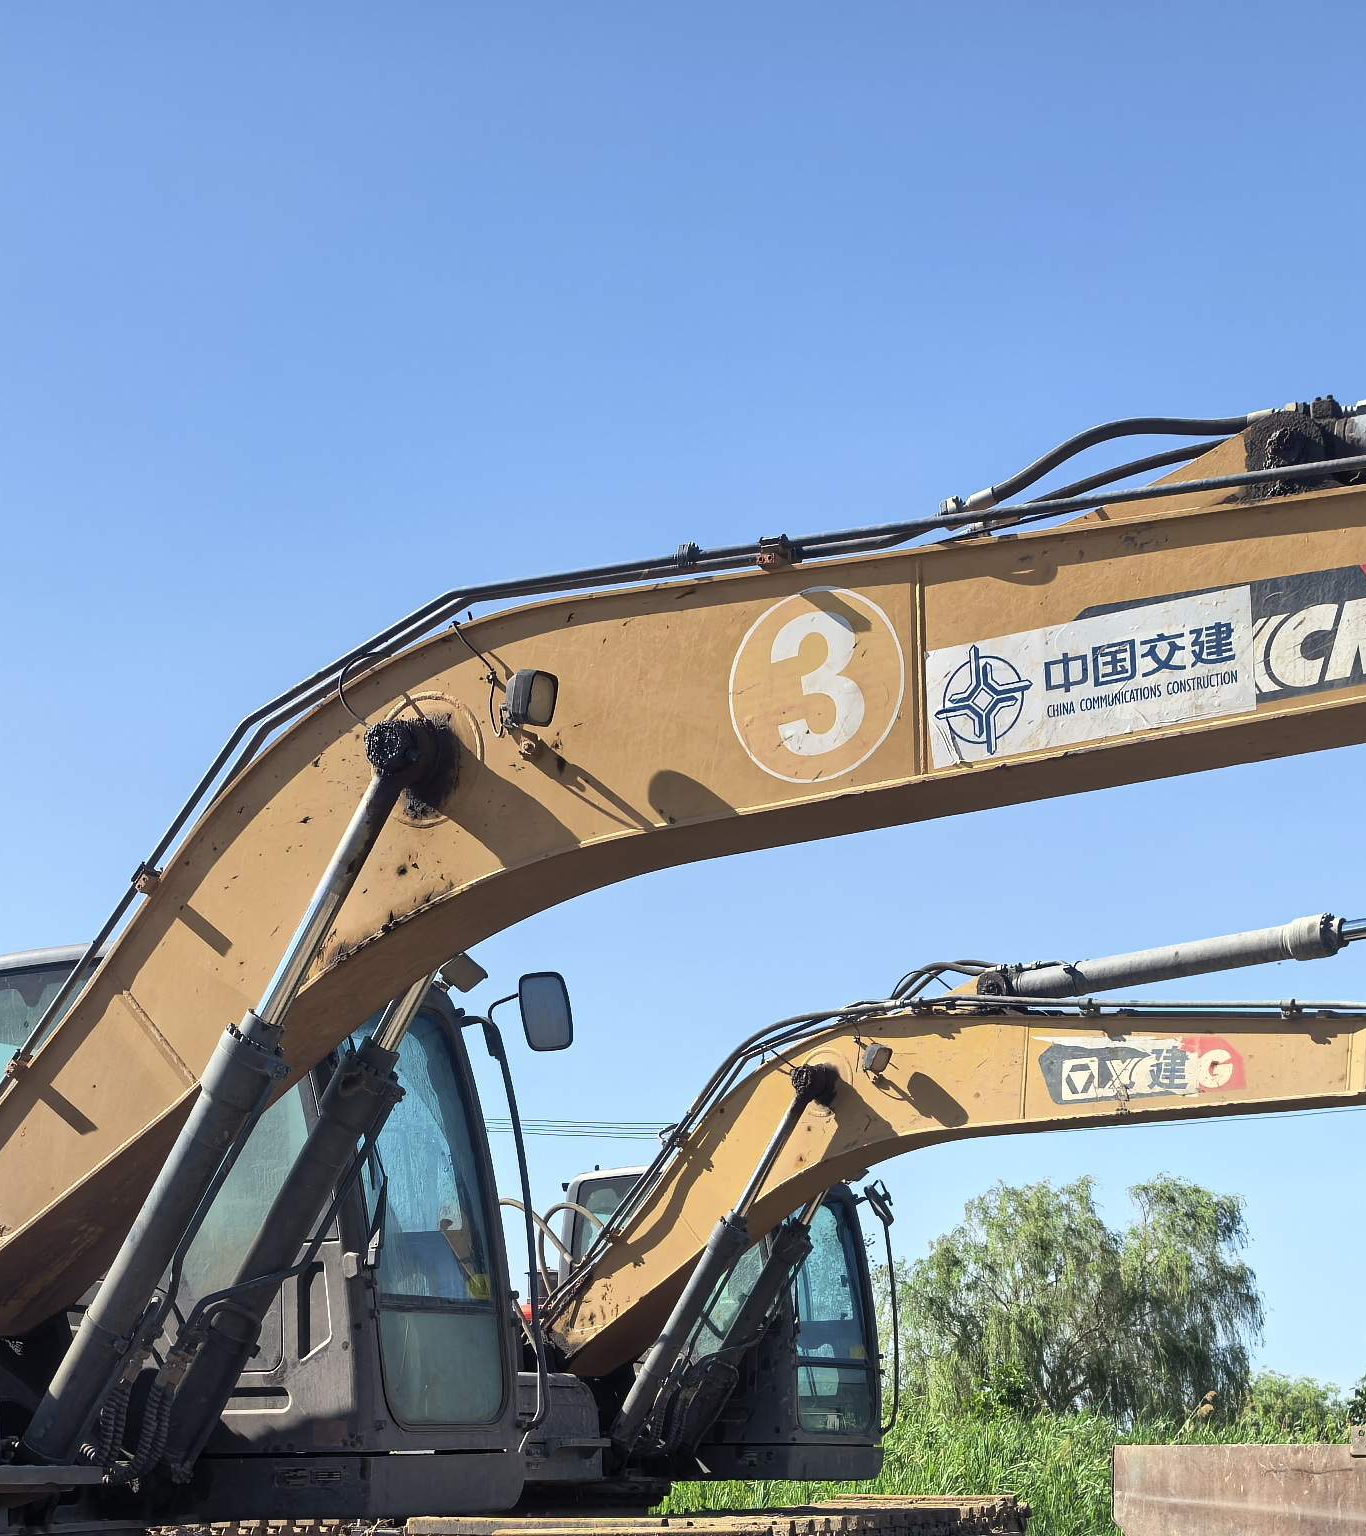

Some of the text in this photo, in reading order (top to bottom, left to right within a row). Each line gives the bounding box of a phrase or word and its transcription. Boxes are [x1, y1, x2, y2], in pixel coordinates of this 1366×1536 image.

[770, 611, 866, 757] 3
[1044, 621, 1236, 693] 中国交建
[1046, 670, 1238, 718] CHINA COMMUNICATIONS CONSTRUCTION
